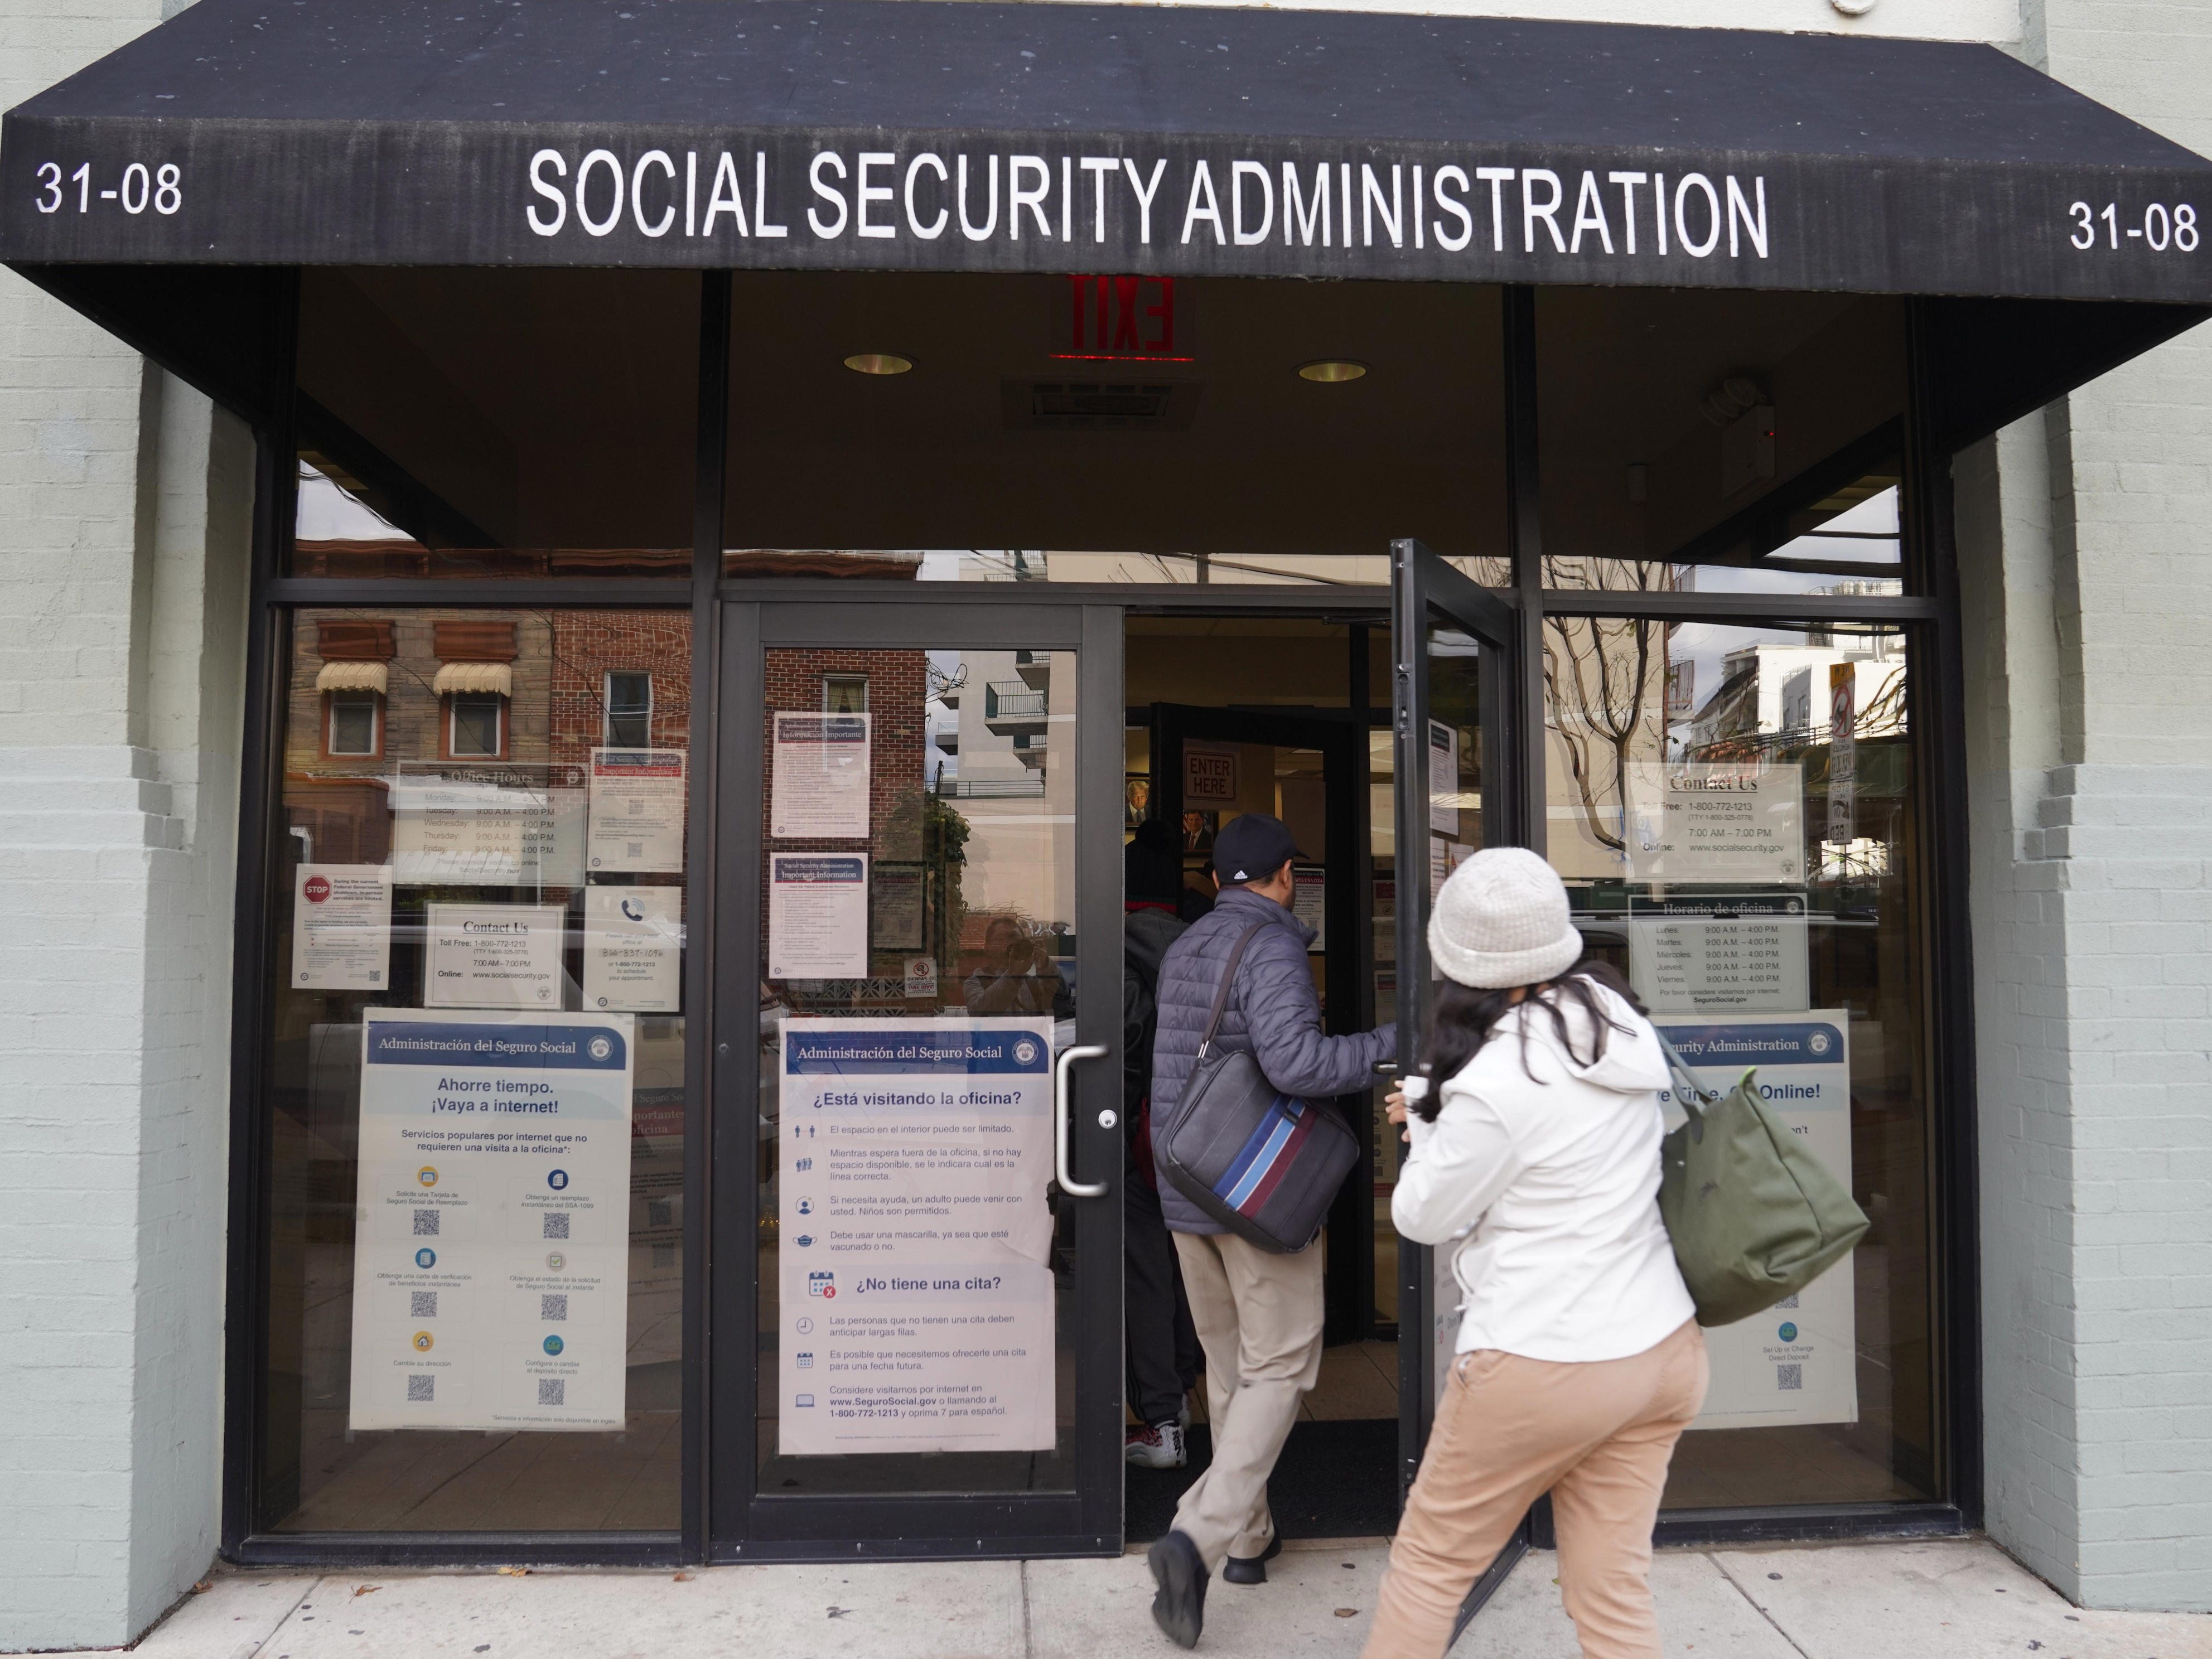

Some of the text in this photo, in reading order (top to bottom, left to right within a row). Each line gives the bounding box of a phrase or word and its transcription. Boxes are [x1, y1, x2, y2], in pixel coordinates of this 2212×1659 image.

[36, 162, 182, 215] 31-08
[526, 149, 1768, 259] SOCIAL SECURITY ADMINISTRATION
[2069, 201, 2199, 252] 31-08
[827, 731, 862, 739] Importante
[1190, 758, 1230, 776] ENTER
[451, 770, 534, 782] Office Hours
[1670, 776, 1757, 790] Contact Us
[1194, 777, 1226, 795] HERE
[1662, 802, 1682, 811] Free:
[1688, 802, 1752, 810] 1-800-772-1213
[1688, 828, 1707, 837] 7:00
[1709, 828, 1725, 836] AM
[1735, 829, 1754, 837] 7:00
[1643, 843, 1784, 854] Online: www.socialsecurity.gov
[782, 871, 815, 879] Important
[1663, 902, 1774, 915] Horario de oficina
[463, 921, 529, 934] Contact Us
[472, 971, 550, 980] www.socialsecurity.gov
[379, 1037, 576, 1055] Administración del Seguro Social
[1707, 1038, 1799, 1052] Administration
[798, 1046, 1002, 1061] Administración del Seguro Social
[437, 1078, 553, 1097] Ahorre tiempo.
[1760, 1084, 1820, 1099] Online!
[432, 1097, 558, 1114] ¡Vaya a internet!
[814, 1091, 1021, 1108] ¿Está visitando la oficina?
[402, 1129, 445, 1139] Servicios
[447, 1131, 495, 1142] populares
[498, 1134, 513, 1143] por
[516, 1133, 552, 1141] internet
[554, 1135, 572, 1143] que
[841, 1125, 875, 1135] espacio
[933, 1124, 959, 1134] puede
[978, 1124, 1013, 1133] limitado.
[417, 1142, 461, 1152] requieren
[485, 1143, 509, 1152] visita
[857, 1276, 1001, 1293] ¿No tiene una cita?
[829, 1385, 873, 1394] Considere
[876, 1385, 917, 1394] visitarnos
[936, 1385, 968, 1393] internet
[830, 1396, 936, 1408] www.SeguroSocial.gov
[947, 1395, 986, 1404] llamando
[830, 1408, 898, 1418] 1-800-772-1213
[909, 1408, 938, 1418] oprima
[949, 1409, 968, 1418] para
[971, 1406, 1007, 1416] español.
